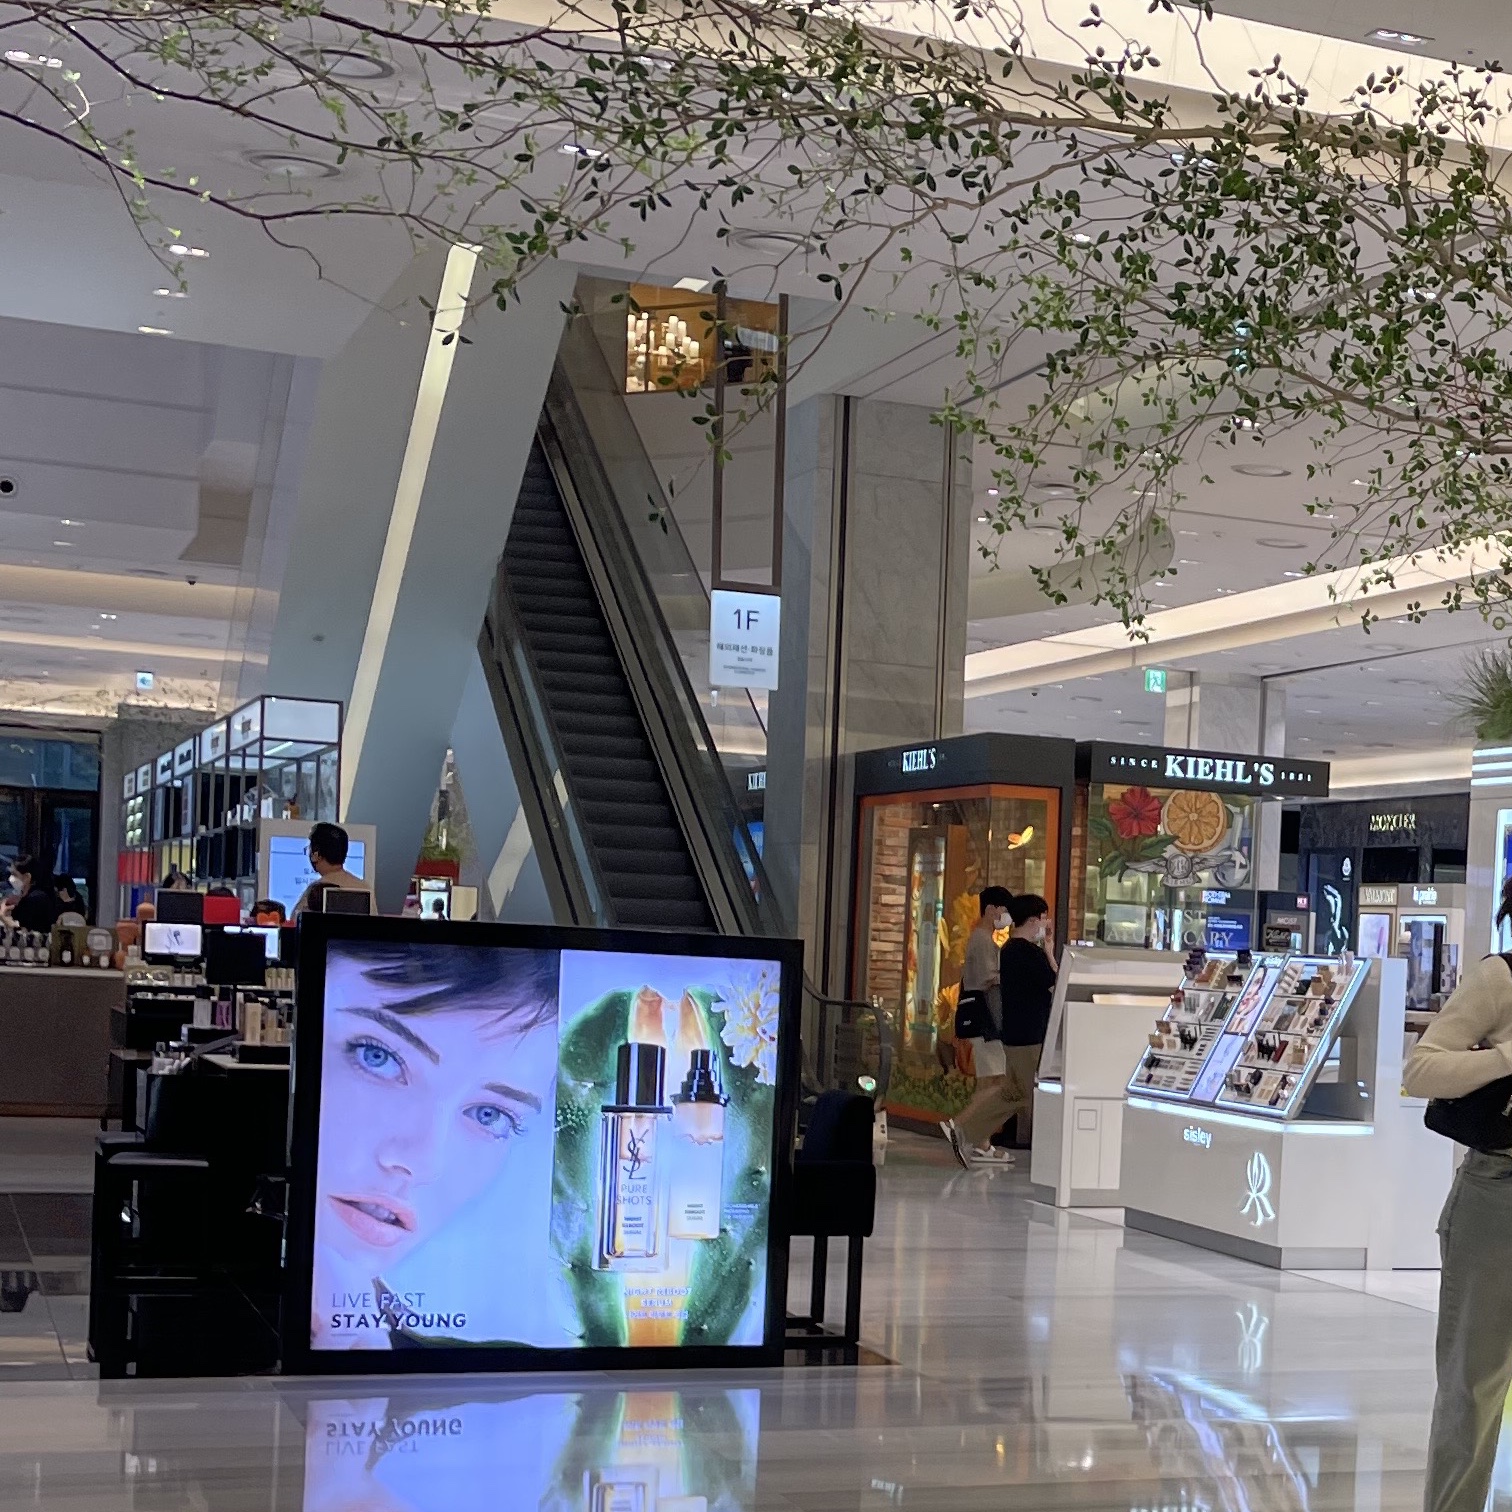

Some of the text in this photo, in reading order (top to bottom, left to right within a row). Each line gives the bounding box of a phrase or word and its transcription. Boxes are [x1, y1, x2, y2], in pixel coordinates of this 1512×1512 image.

[733, 608, 760, 630] 1F
[902, 747, 937, 772] KIEHL'S
[1110, 756, 1158, 768] SINCE
[1164, 754, 1275, 786] KIEHL'S
[1183, 1125, 1212, 1149] sisley
[621, 1183, 648, 1194] PURE
[616, 1195, 652, 1206] SHOTS
[332, 1291, 426, 1310] LIVE FAST
[331, 1313, 467, 1330] STAY YOUNG
